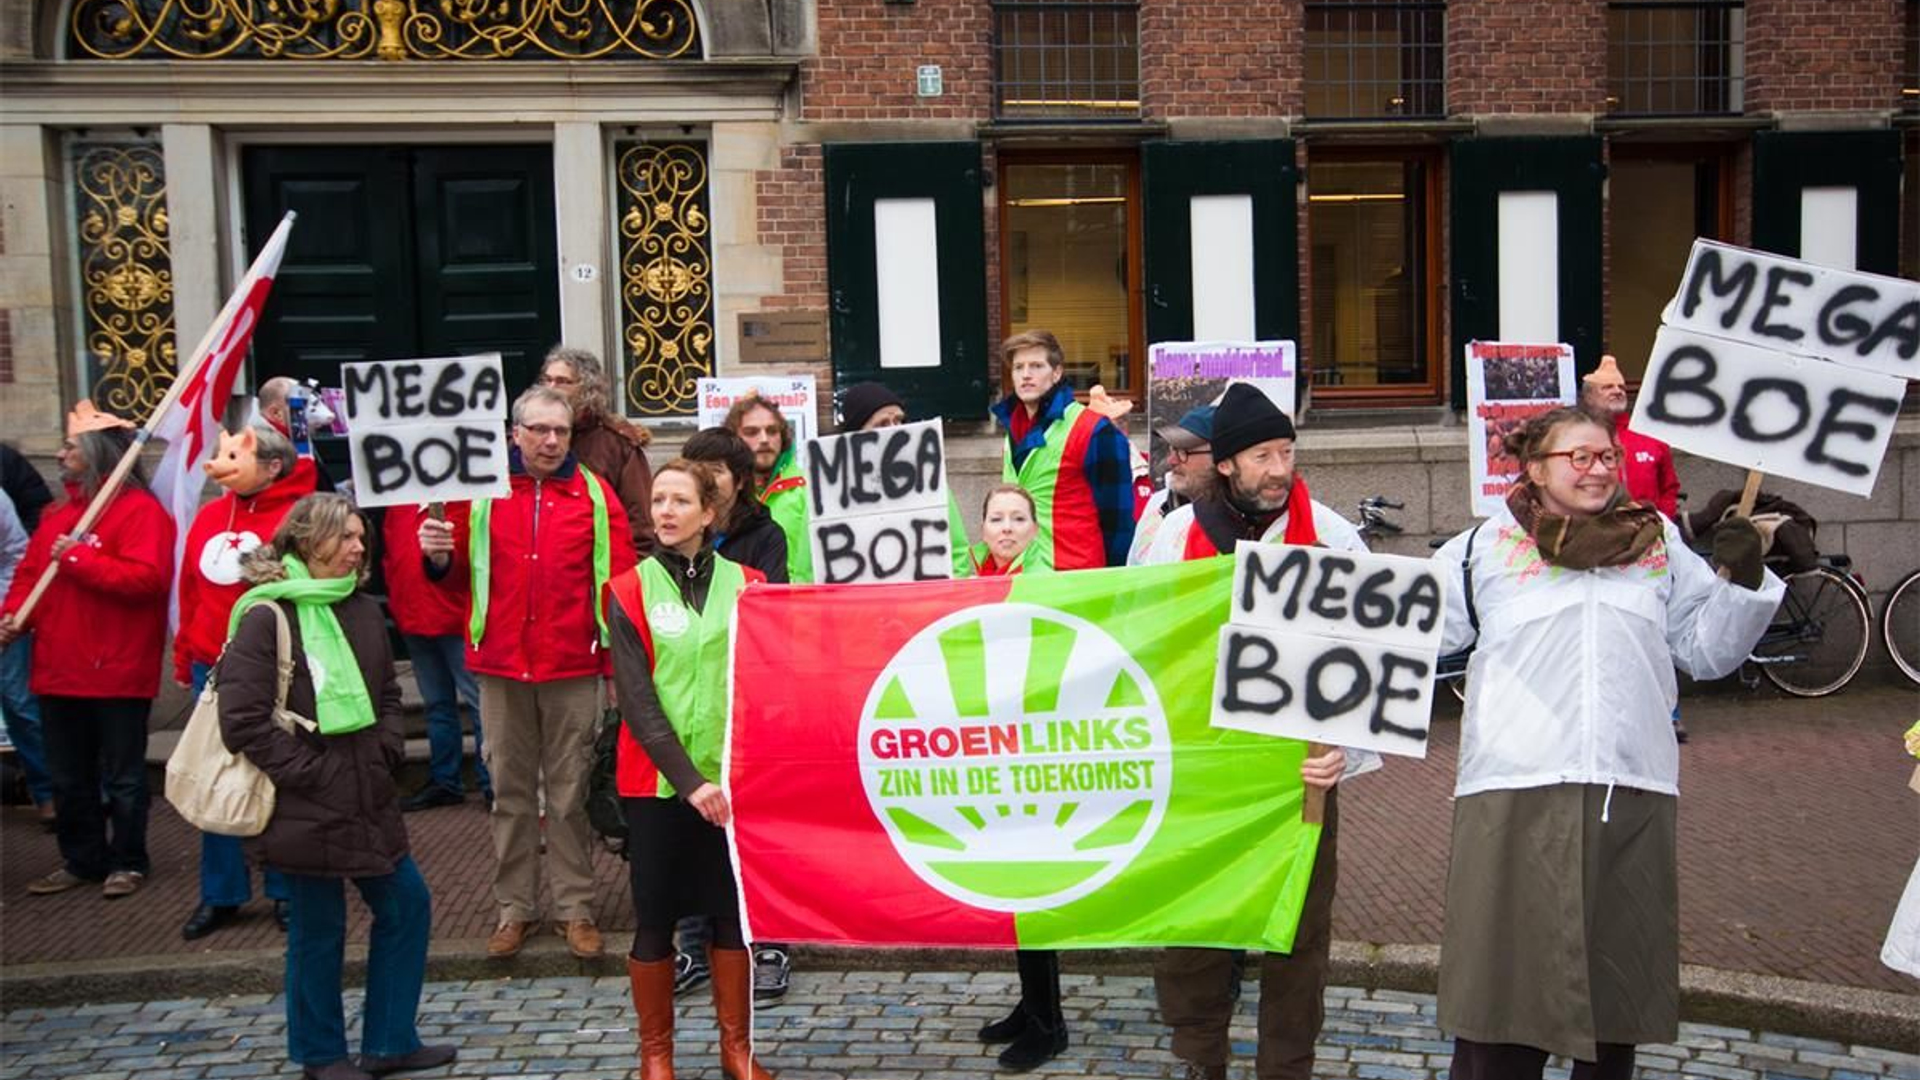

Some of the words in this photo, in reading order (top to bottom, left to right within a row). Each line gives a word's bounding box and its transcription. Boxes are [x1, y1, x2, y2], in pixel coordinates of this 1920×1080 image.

[1682, 248, 1920, 361] MEGA
[344, 362, 501, 419] MEGA
[1646, 345, 1900, 477] BOE
[362, 426, 498, 494] BOE
[807, 427, 942, 516] MEGA
[817, 518, 950, 584] BOE
[1241, 548, 1441, 633] MEGA
[1221, 632, 1429, 741] BOE
[870, 716, 1153, 760] GROENLINKS
[878, 769, 922, 797] ZIN
[931, 767, 959, 796] IN
[967, 765, 1001, 795] DE
[1009, 760, 1155, 794] TOEKOMST
